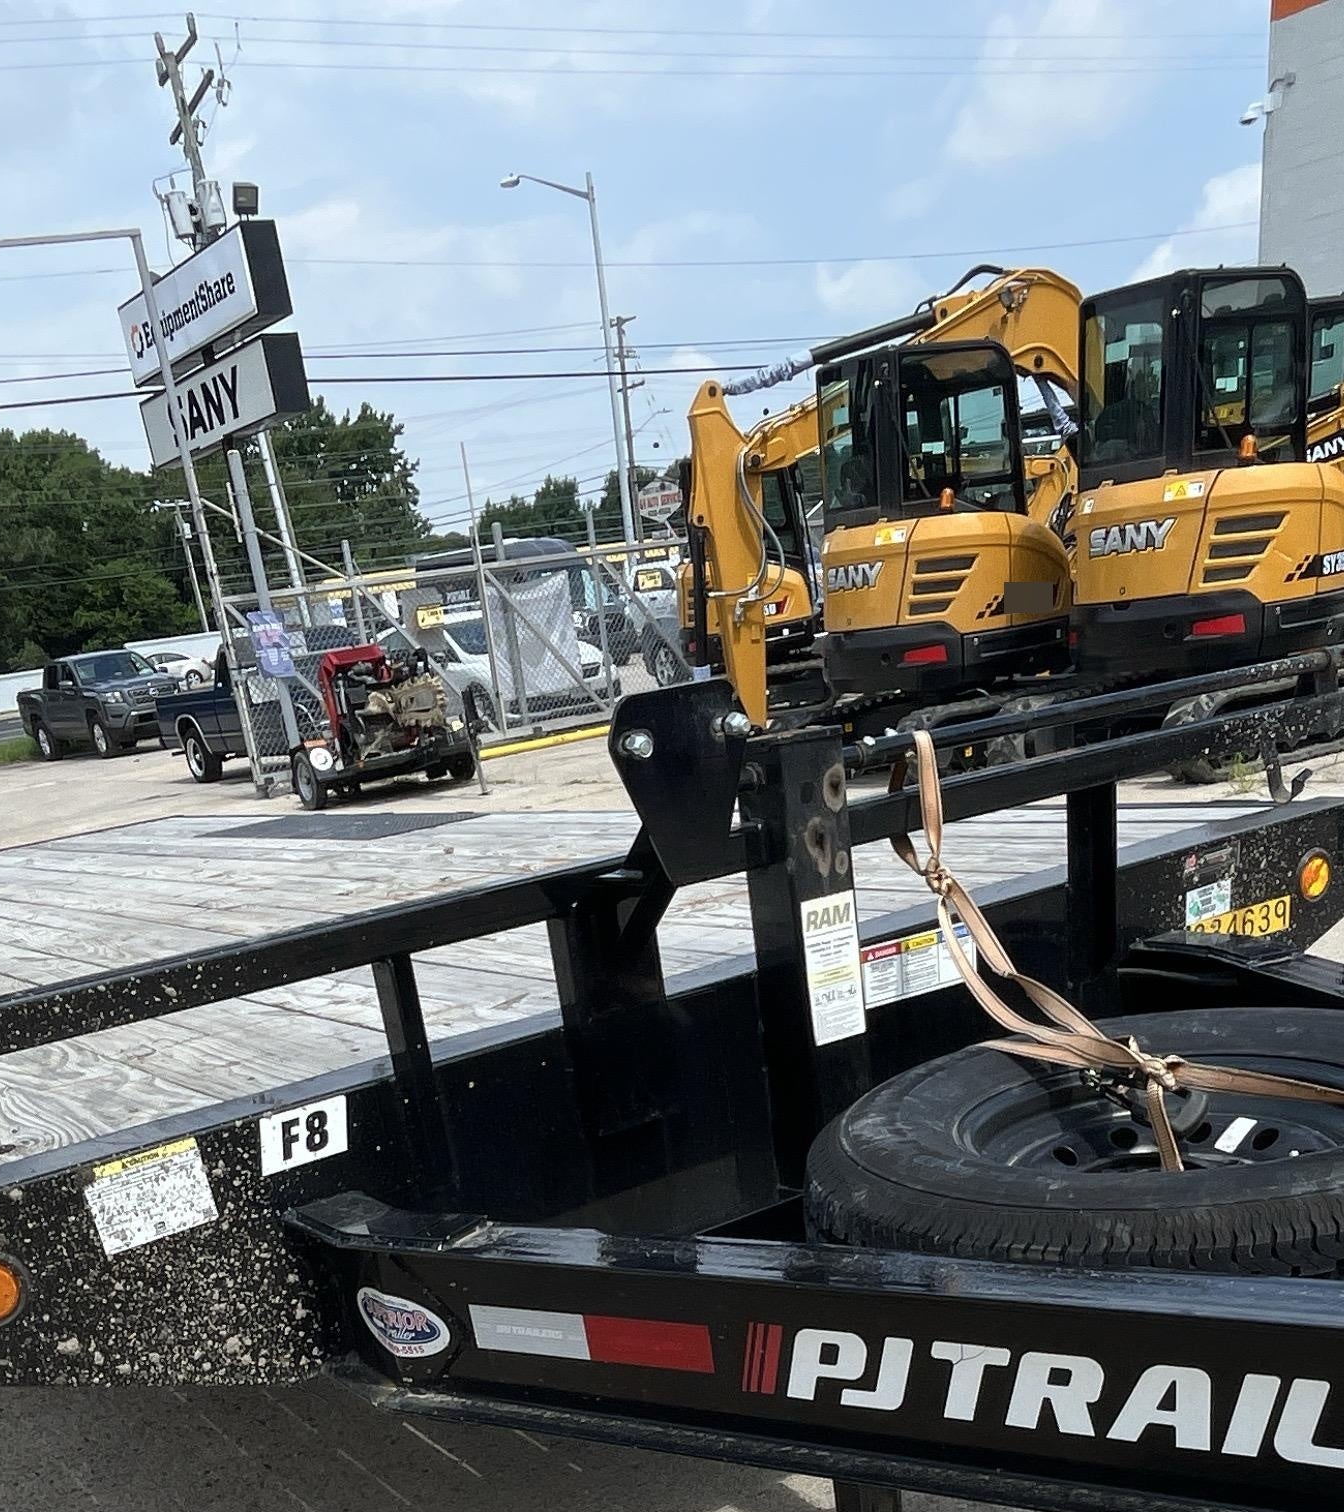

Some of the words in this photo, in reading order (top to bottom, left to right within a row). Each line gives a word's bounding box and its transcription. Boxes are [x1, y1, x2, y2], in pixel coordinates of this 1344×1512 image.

[143, 271, 236, 349] EuipmentShare
[1089, 516, 1177, 556] SANY
[827, 561, 885, 592] SANY
[806, 902, 851, 932] RAM
[281, 1109, 329, 1161] F8
[125, 1152, 160, 1166] CAUTION
[786, 1328, 915, 1411] PJ
